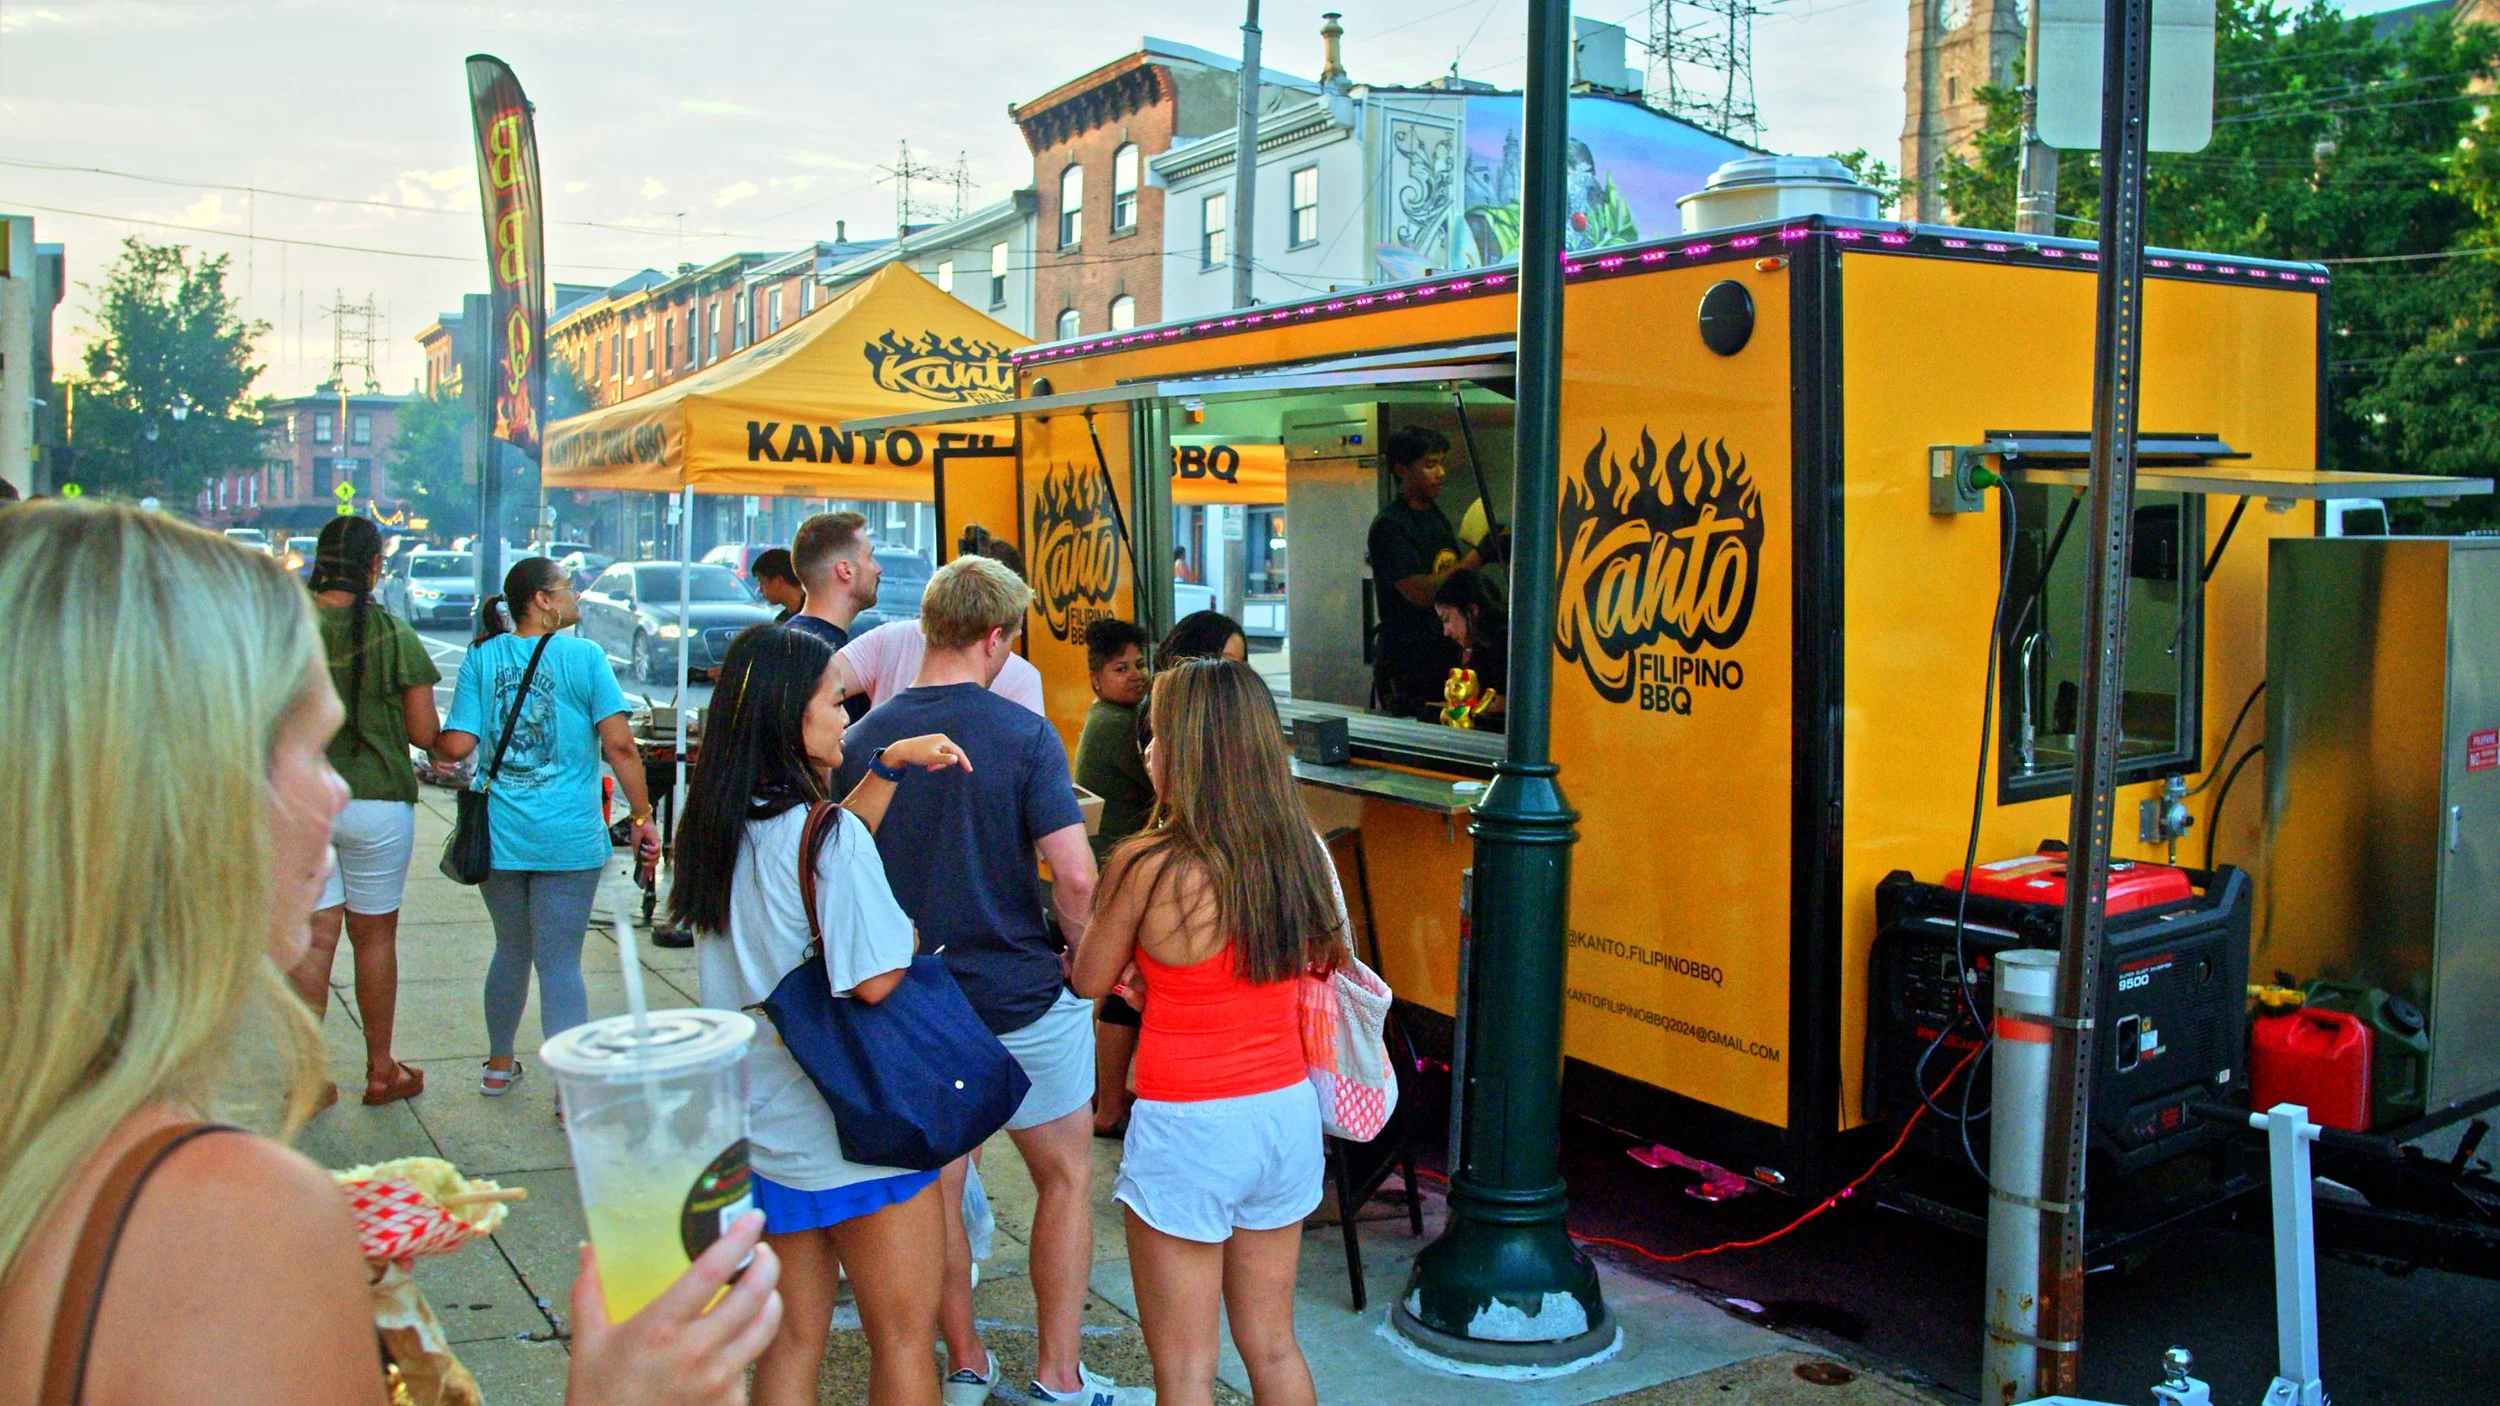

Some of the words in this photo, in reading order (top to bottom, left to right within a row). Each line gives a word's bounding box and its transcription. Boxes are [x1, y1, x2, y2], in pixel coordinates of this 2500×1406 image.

[746, 420, 924, 467] KANTO
[1172, 445, 1240, 484] BQ
[1033, 510, 1117, 638] Kanto
[1556, 503, 1756, 698] Kanto
[1071, 626, 1087, 645] BB
[1640, 653, 1744, 690] FILIPINO
[1640, 683, 1692, 716] BBQ
[1566, 929, 1723, 988] @KANTO.FILIPINOBBQ
[2119, 974, 2150, 991] 9500
